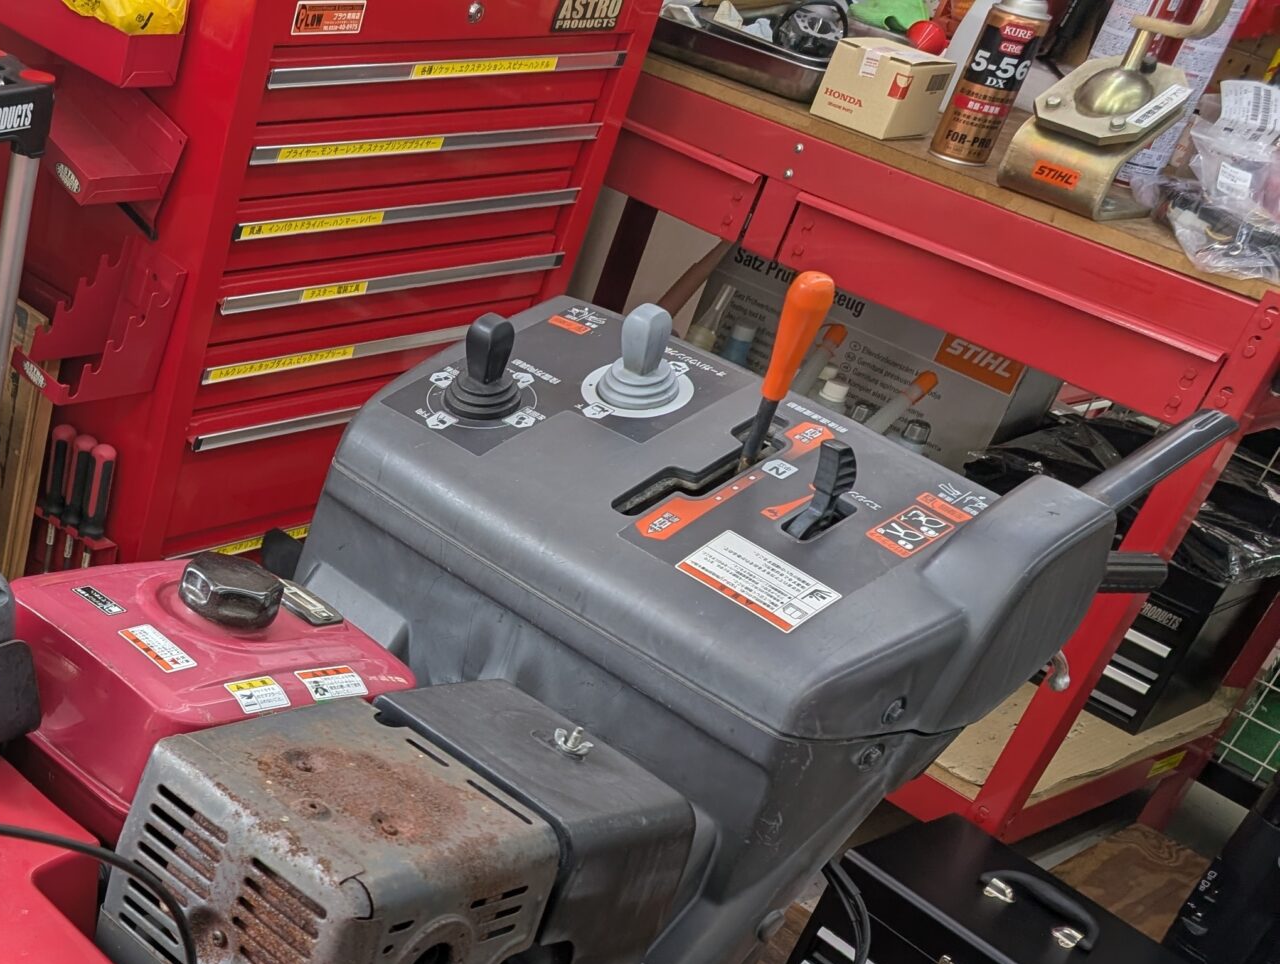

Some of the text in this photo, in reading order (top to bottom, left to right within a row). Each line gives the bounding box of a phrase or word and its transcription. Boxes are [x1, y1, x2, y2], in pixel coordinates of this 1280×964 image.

[558, 0, 621, 20] ASTRO
[555, 17, 616, 30] PRODUCTS
[1003, 25, 1034, 39] KURE
[971, 49, 1032, 81] 5-56
[985, 77, 1007, 89] DX
[823, 87, 863, 107] HONDA
[1035, 165, 1074, 185] STIHL
[734, 248, 762, 273] Satz
[946, 338, 1012, 378] STIHL
[770, 466, 787, 477] N
